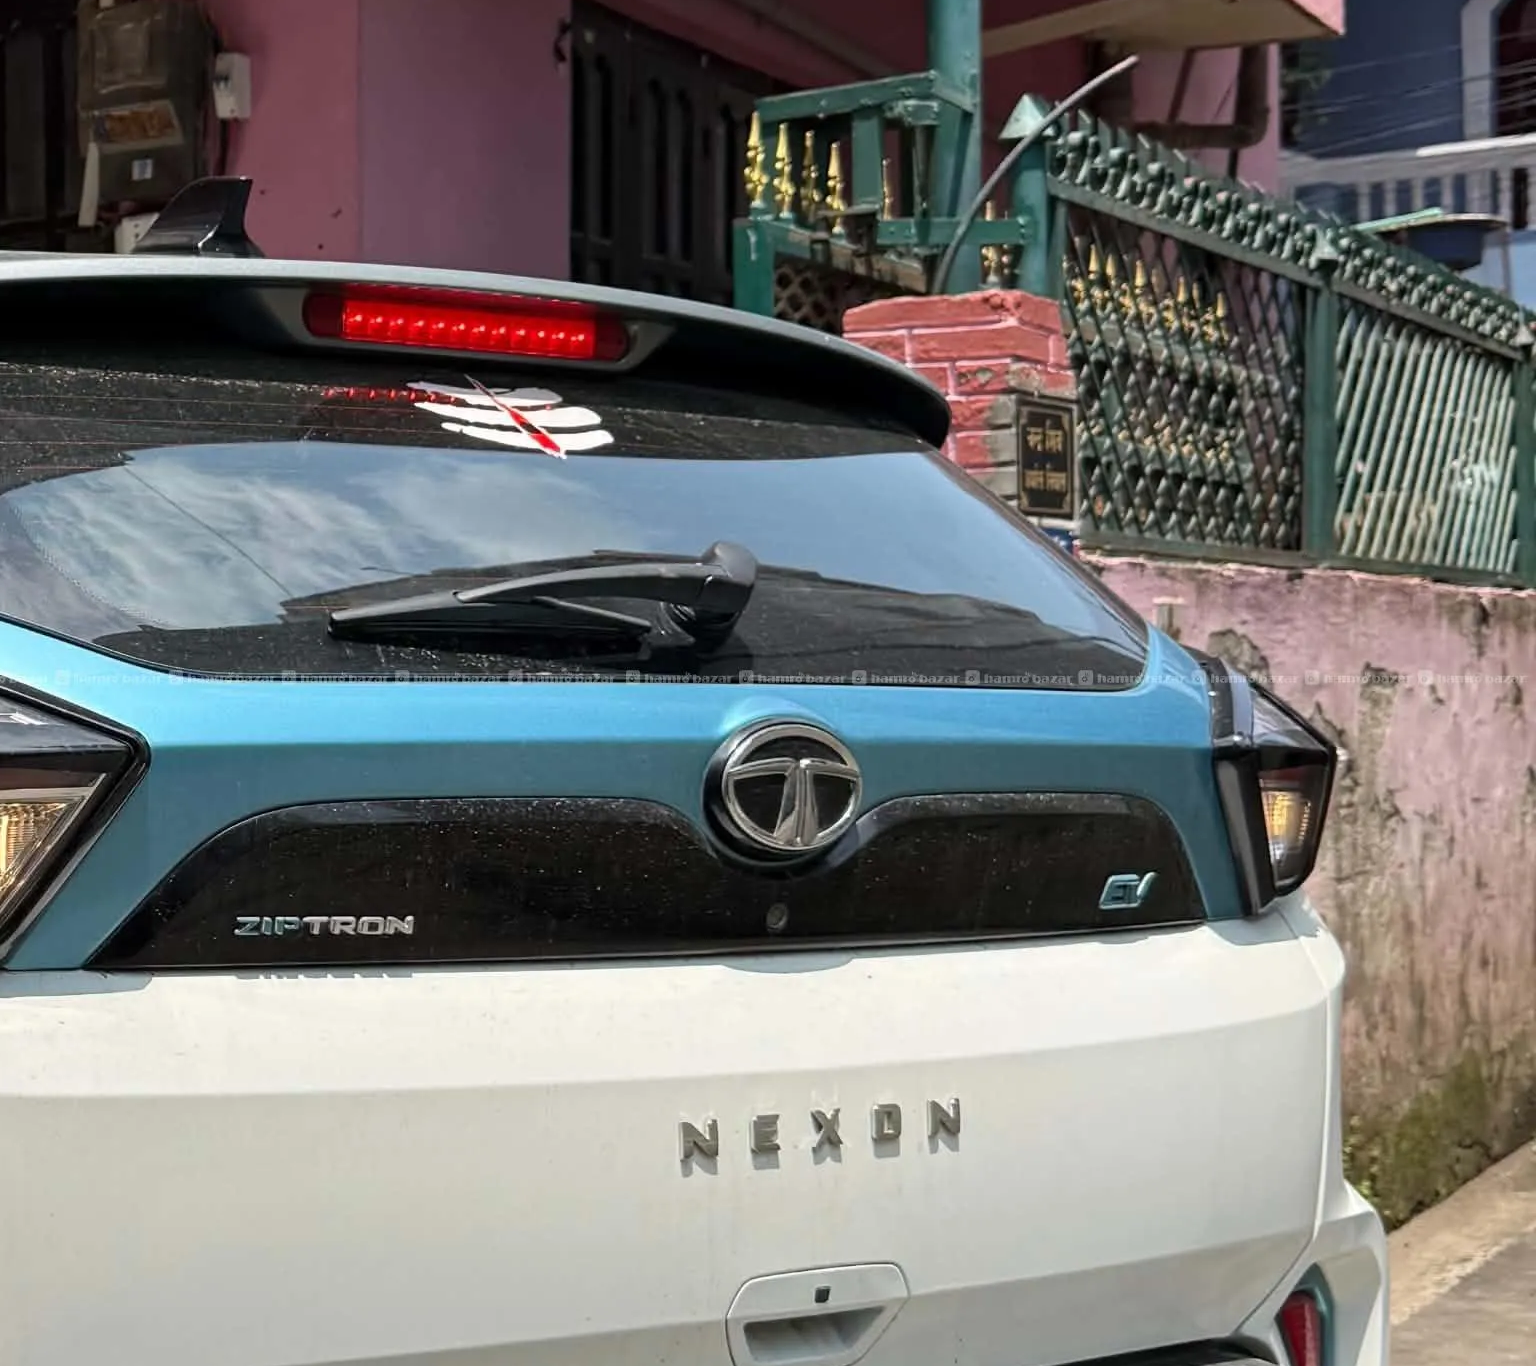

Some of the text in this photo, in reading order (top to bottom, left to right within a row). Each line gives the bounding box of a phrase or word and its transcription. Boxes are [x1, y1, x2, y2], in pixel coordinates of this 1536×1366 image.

[1098, 872, 1160, 911] EV
[233, 915, 415, 936] ZIPTRON
[678, 1096, 962, 1162] NEXON
